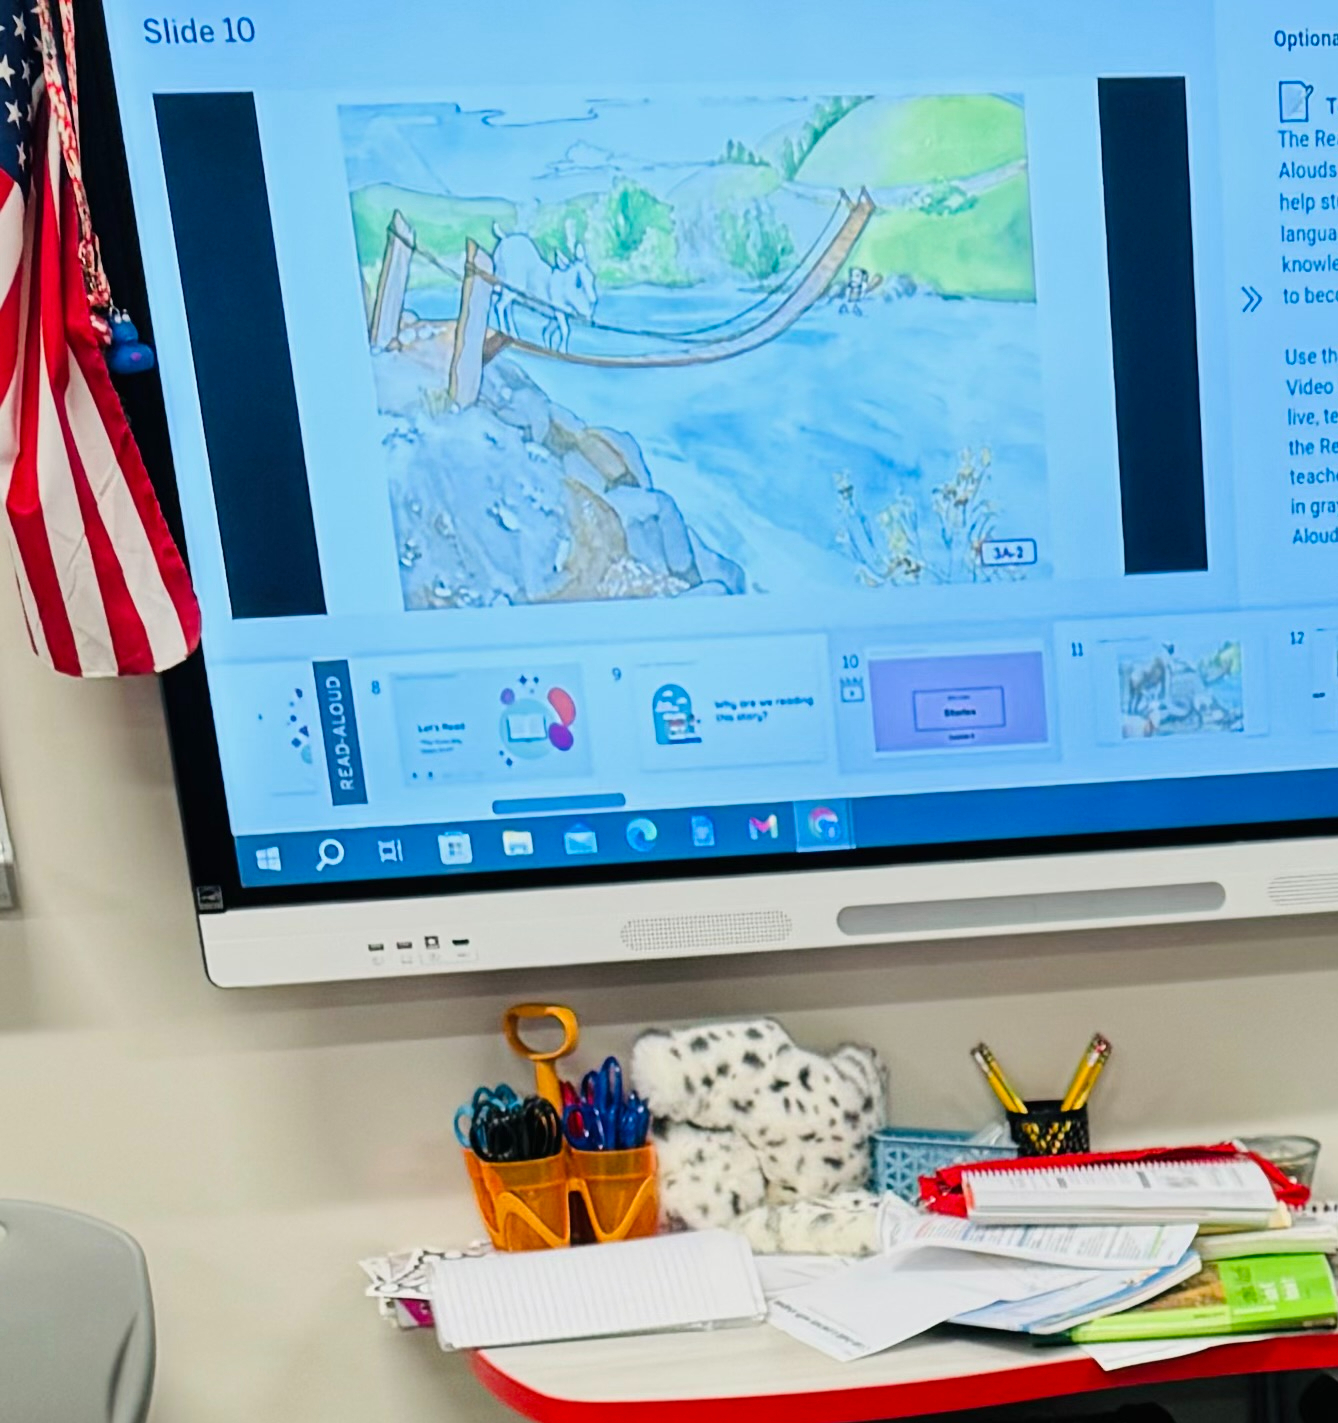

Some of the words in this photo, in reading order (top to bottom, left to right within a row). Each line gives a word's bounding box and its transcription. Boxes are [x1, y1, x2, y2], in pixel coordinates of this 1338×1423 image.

[143, 17, 214, 44] Slide
[222, 16, 255, 43] 10
[1276, 129, 1310, 149] The
[1278, 160, 1338, 180] Alouds
[1279, 192, 1316, 216] help
[1282, 288, 1300, 305] to
[1284, 348, 1318, 366] Use
[1285, 377, 1335, 397] Video
[1287, 407, 1320, 427] live,
[1288, 438, 1315, 457] the
[1290, 497, 1306, 516] in
[1290, 630, 1305, 646] 12
[1071, 641, 1085, 658] 11
[842, 653, 860, 670] 10
[612, 667, 622, 682] 9
[371, 680, 381, 695] 8
[714, 700, 738, 711] Why
[739, 699, 757, 708] are
[759, 698, 773, 707] we
[775, 696, 814, 707] reading
[736, 710, 768, 723] story?
[325, 675, 355, 791] READ-ALOUD
